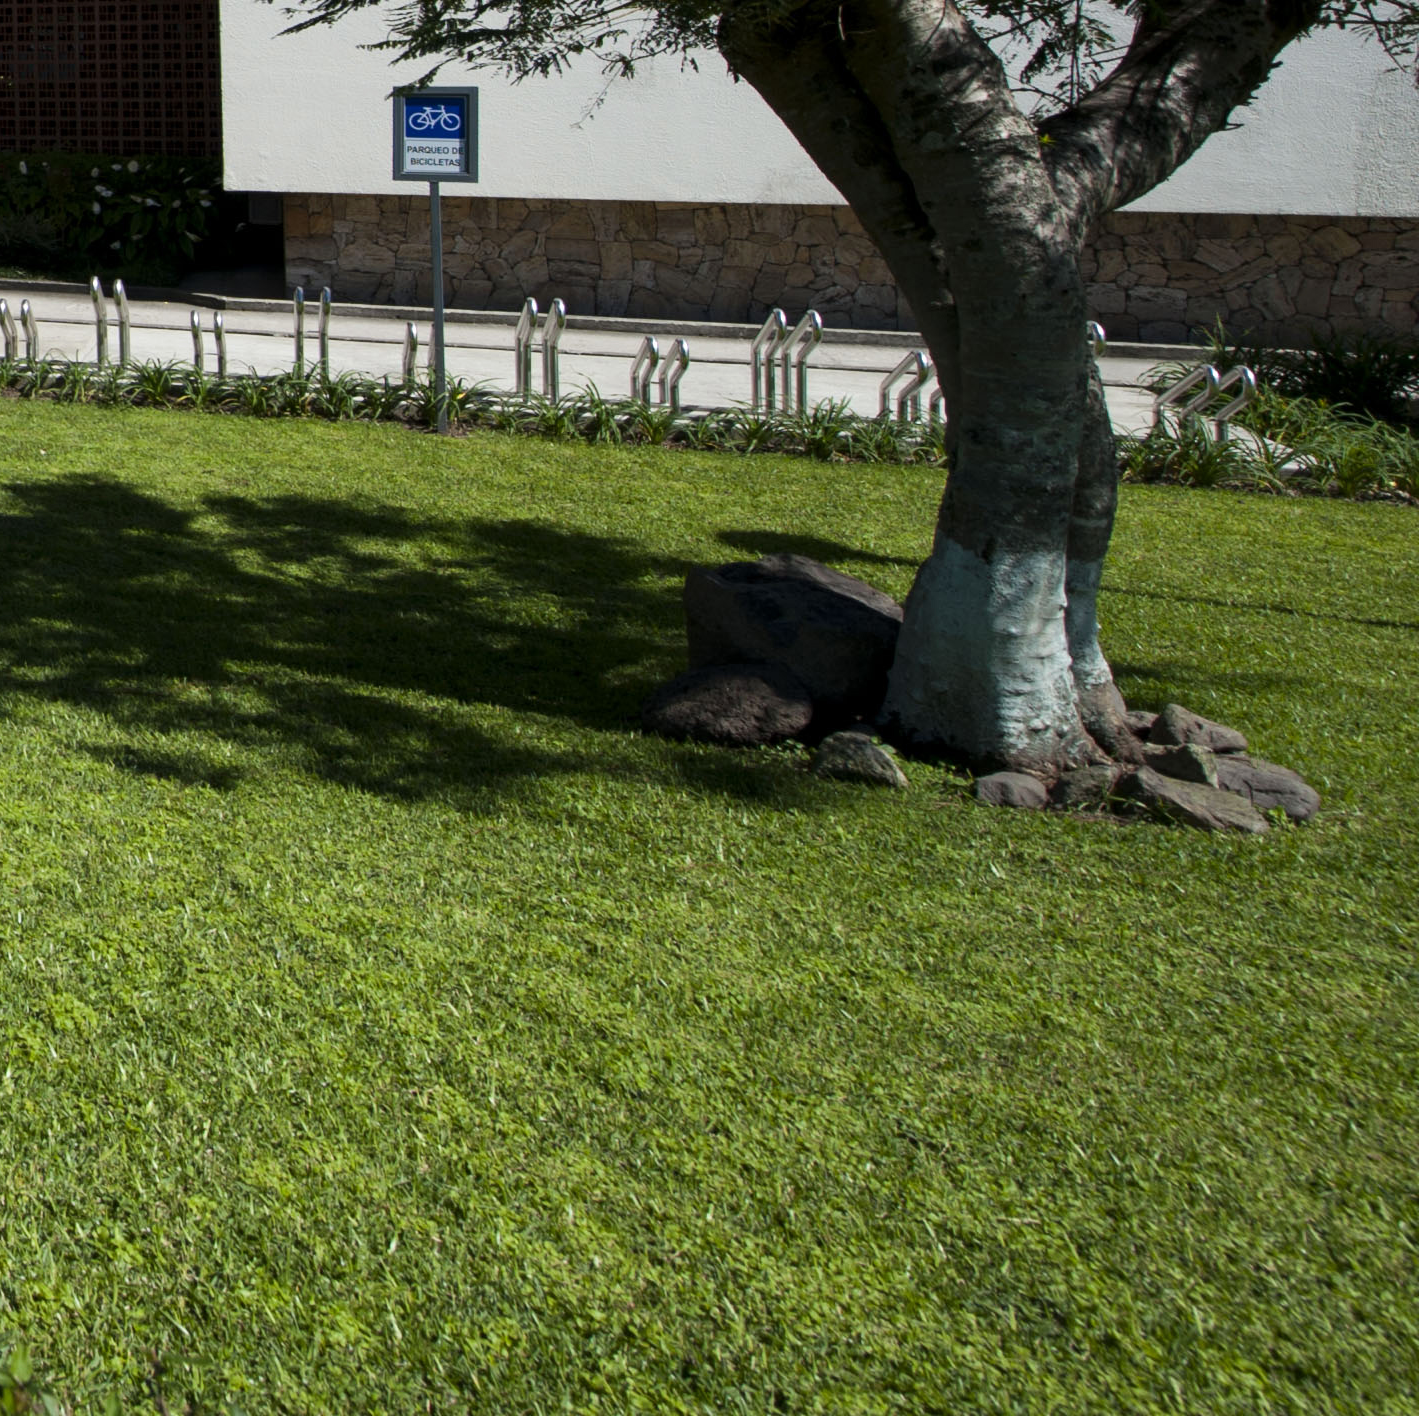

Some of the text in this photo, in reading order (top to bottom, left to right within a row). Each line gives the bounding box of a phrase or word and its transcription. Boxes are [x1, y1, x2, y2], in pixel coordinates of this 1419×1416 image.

[407, 145, 465, 155] PARQUEO DE
[410, 157, 461, 167] BICICLETAS
